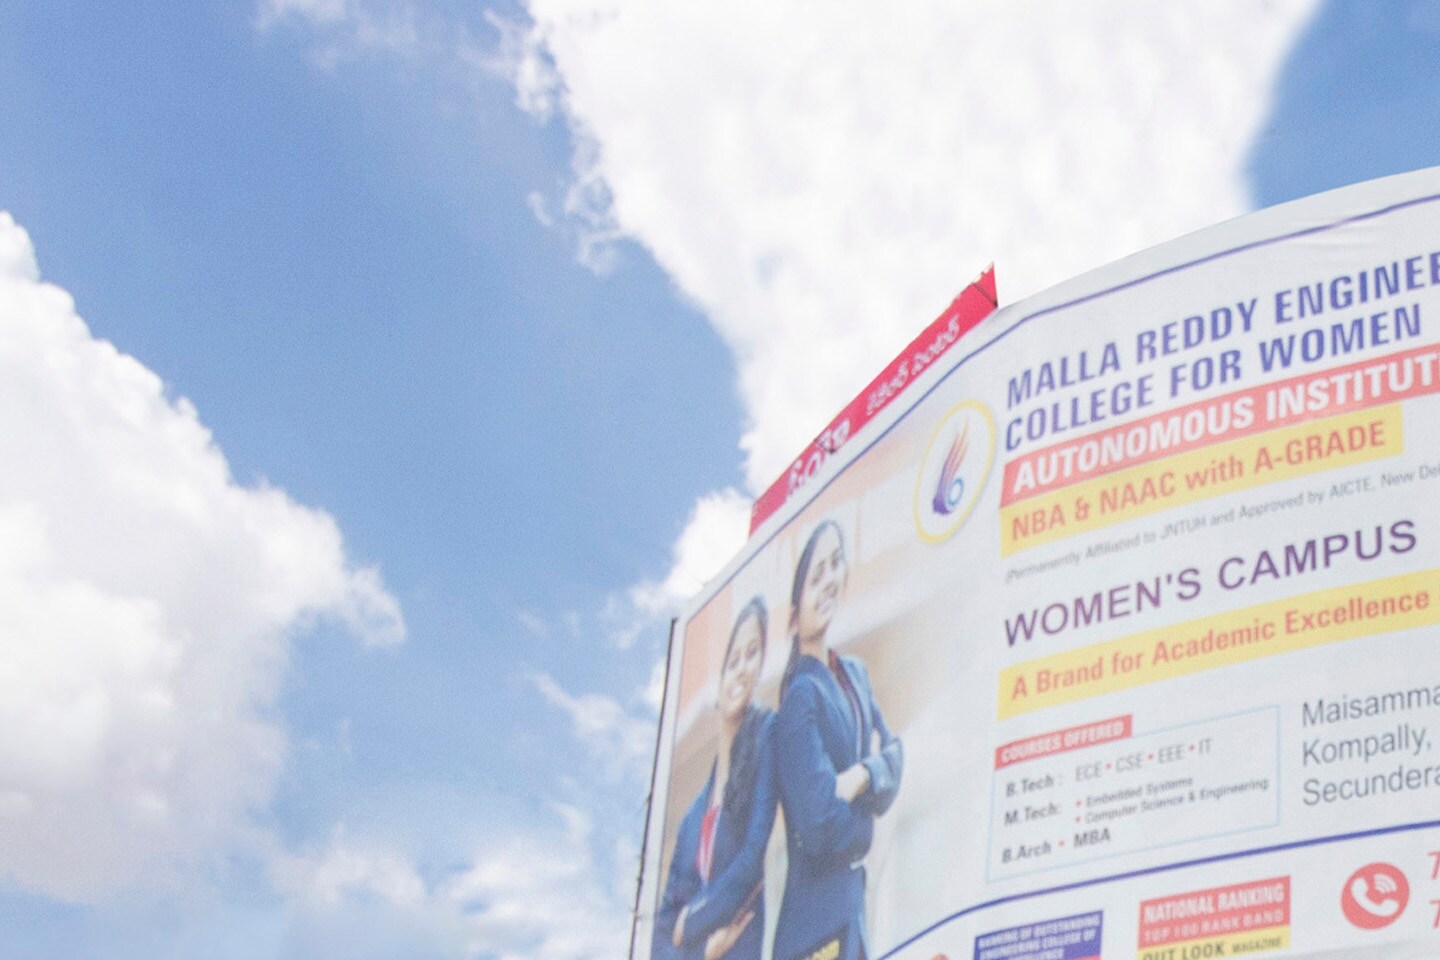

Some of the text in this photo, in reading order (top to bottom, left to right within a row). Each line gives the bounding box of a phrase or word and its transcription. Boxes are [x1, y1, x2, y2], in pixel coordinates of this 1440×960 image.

[1005, 303, 1420, 452] COLLEGE FOR WOMEN
[1007, 342, 1120, 410] MALLA
[1137, 297, 1258, 363] REDDY
[1012, 395, 1254, 494] AUTONOMOUS
[1012, 420, 1385, 541] NBA & NAAC with A-GRADE
[1210, 508, 1235, 526] and
[1239, 493, 1303, 521] Approved
[1307, 488, 1324, 506] by
[1381, 470, 1414, 488] New
[1005, 519, 1417, 648] WOMEN'S CAMPUS
[1012, 676, 1027, 700] A
[1036, 657, 1103, 694] Brand
[1112, 649, 1144, 674] for
[1152, 618, 1276, 666] Academic
[1284, 586, 1430, 635] Excellence
[1076, 763, 1101, 782] ECE
[1115, 753, 1143, 772] CSE
[1158, 744, 1185, 763] EEE
[1198, 738, 1212, 755] IT
[1302, 723, 1432, 767] Kompally,
[1086, 786, 1141, 806] Embedded
[1146, 777, 1193, 795] Systems
[1199, 778, 1270, 800] Engineering
[1073, 828, 1111, 848] MBA
[1144, 893, 1215, 924] NATIONAL
